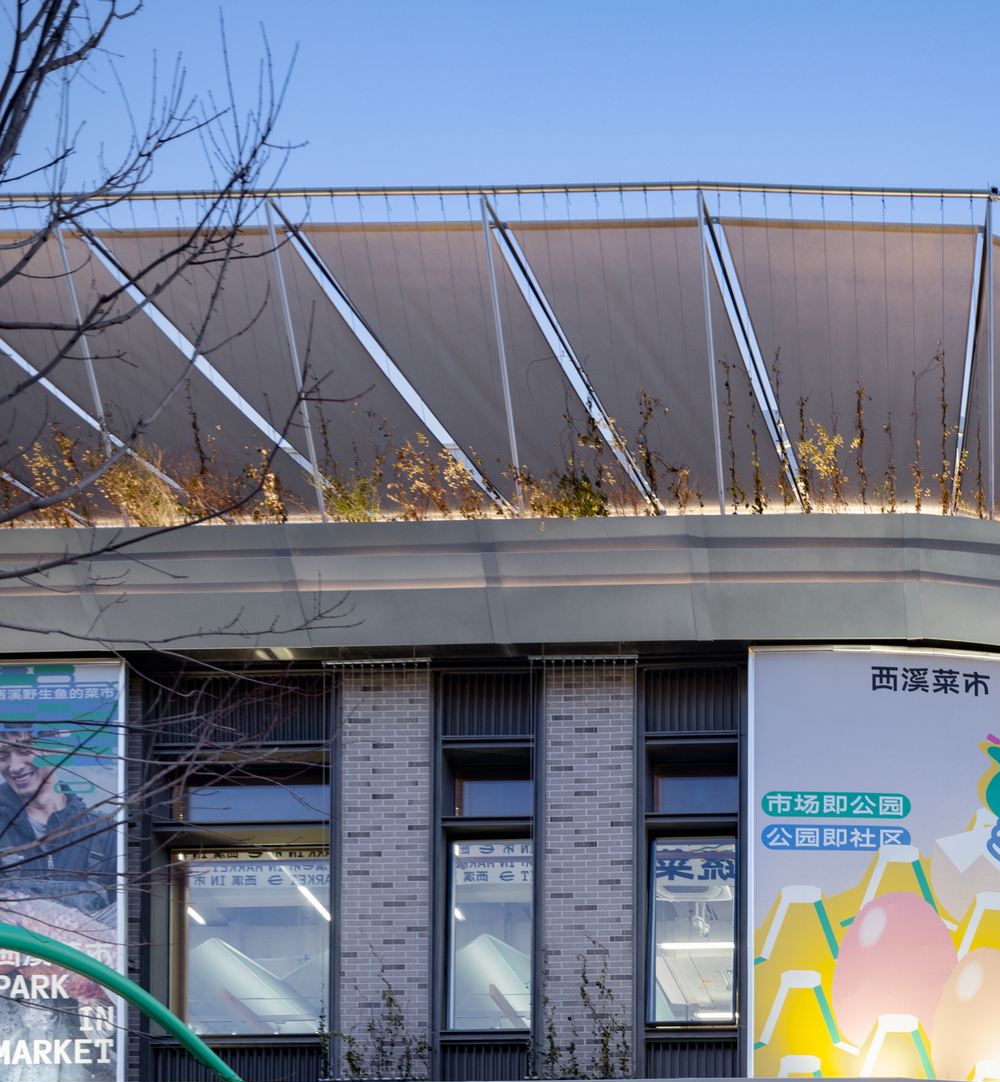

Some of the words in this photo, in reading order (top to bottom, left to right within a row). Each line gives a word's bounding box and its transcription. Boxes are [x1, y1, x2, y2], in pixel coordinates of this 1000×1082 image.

[871, 665, 990, 697] 西溪菜市
[766, 793, 904, 816] 市场即公园
[766, 827, 904, 848] 公园即社区
[79, 1006, 114, 1031] IN
